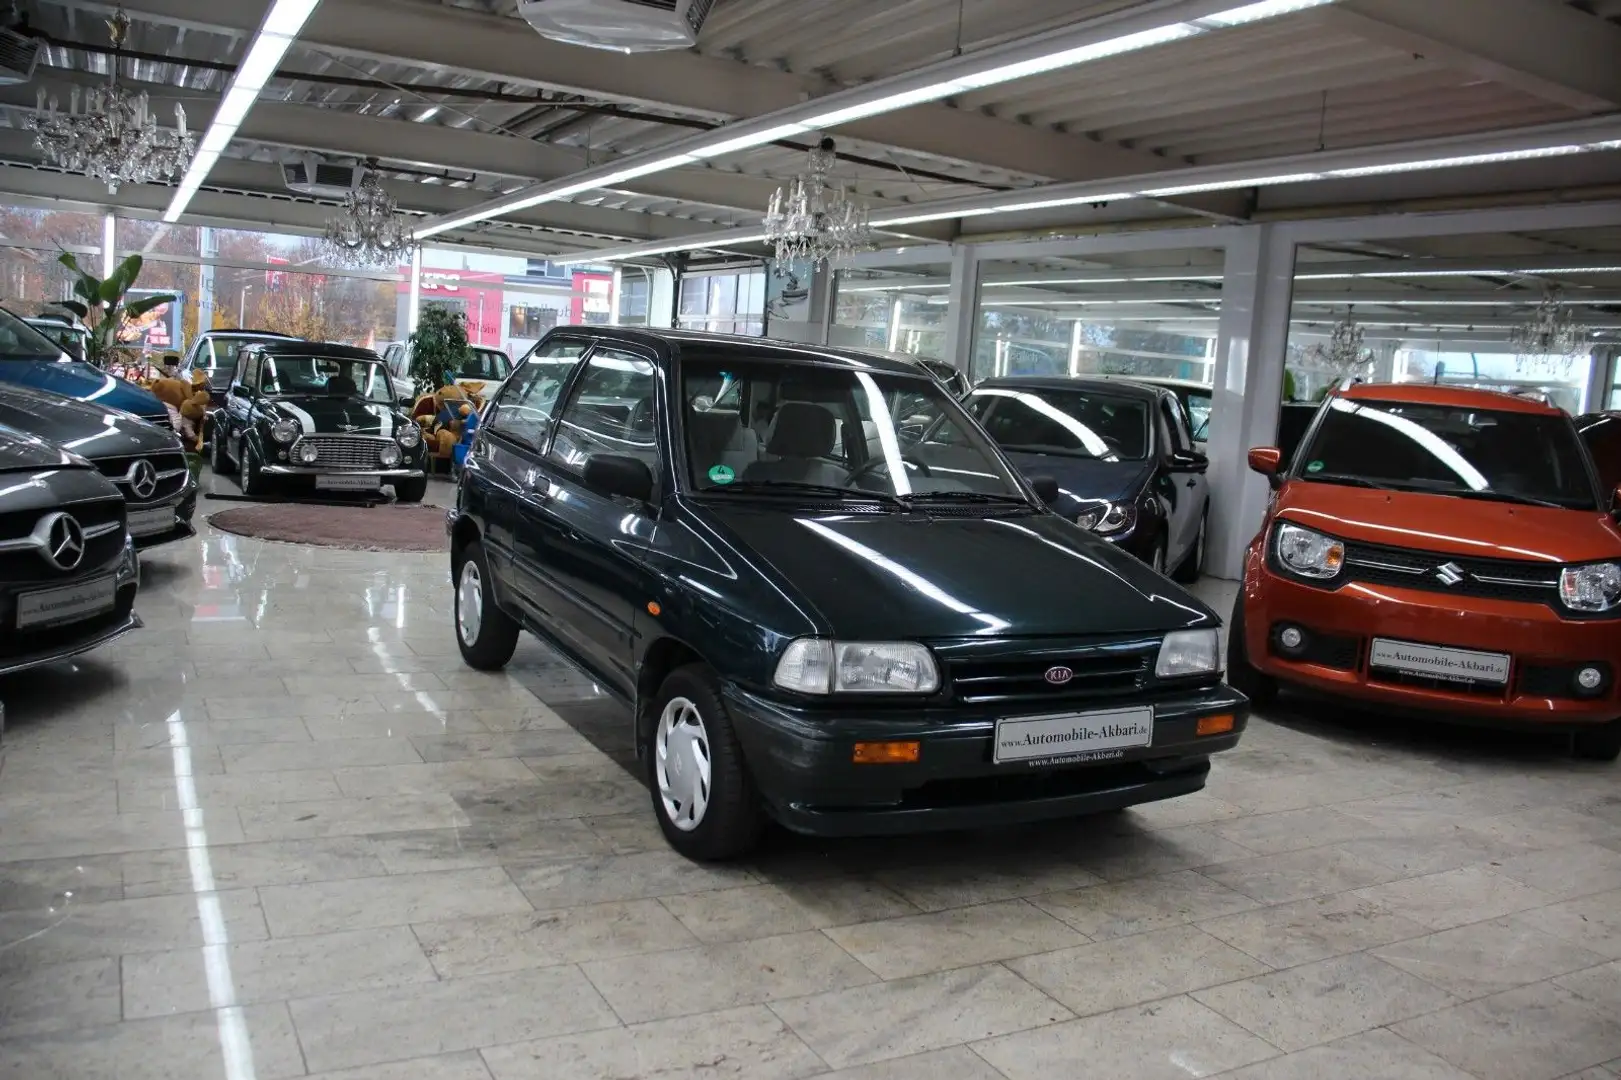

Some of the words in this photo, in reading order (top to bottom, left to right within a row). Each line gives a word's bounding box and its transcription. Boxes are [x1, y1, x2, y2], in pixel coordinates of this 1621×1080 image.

[1049, 669, 1069, 681] KIA
[1000, 722, 1148, 749] www.Automobile-Akbari.de
[1028, 750, 1124, 768] www.Automobile-Akbari.de
